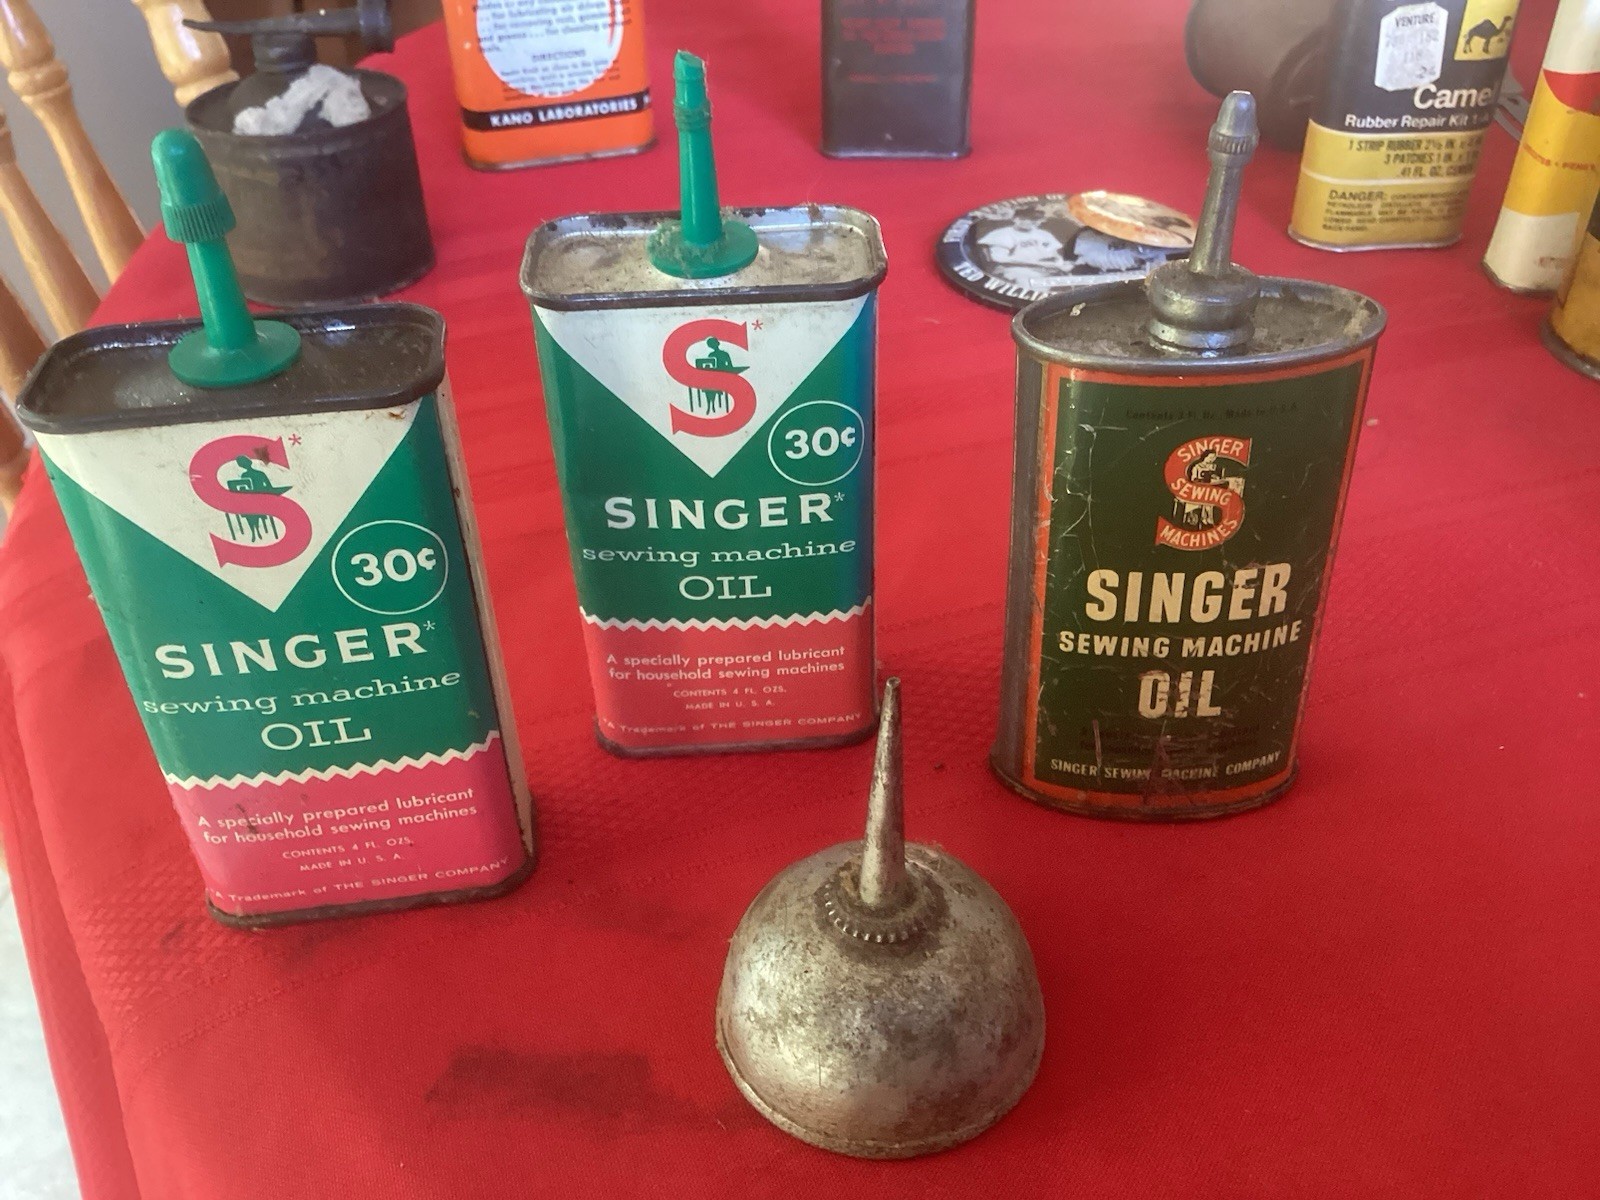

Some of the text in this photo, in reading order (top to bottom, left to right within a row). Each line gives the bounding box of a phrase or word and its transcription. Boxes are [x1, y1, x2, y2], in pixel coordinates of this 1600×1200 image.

[1395, 12, 1435, 27] VENTURE
[490, 112, 534, 127] KANO
[538, 97, 638, 122] LABORATORIES
[1344, 113, 1399, 129] Rubber
[1400, 114, 1447, 129] Repair
[1448, 113, 1469, 127] Kit
[1356, 139, 1385, 151] STRIP
[1386, 138, 1423, 150] RUBBER
[1384, 153, 1391, 164] 3
[1392, 152, 1434, 164] PATCHES
[1329, 189, 1387, 201] DANGER:
[953, 261, 985, 282] TED
[784, 425, 856, 460] 30¢
[1177, 438, 1244, 463] SINGER
[1171, 477, 1232, 506] SEWING
[1160, 518, 1238, 547] MACHINES
[350, 546, 437, 587] 30¢
[583, 539, 857, 568] sewing machine
[679, 575, 772, 600] OIL
[1085, 562, 1292, 624] SINGER
[1059, 619, 1302, 659] SEWING MACHINE
[606, 646, 845, 668] A specially prepared lubricant
[609, 662, 845, 680] for household sewing machines
[143, 671, 461, 715] sewing machine
[673, 689, 727, 698] CONTENTS
[762, 685, 787, 694] OZS.
[1138, 669, 1222, 719] OIL
[685, 702, 714, 710] MADE
[261, 717, 372, 751] OIL
[692, 723, 705, 731] of
[710, 721, 736, 730] THE
[742, 718, 792, 728] SINGER
[797, 711, 861, 725] COMPANY
[1051, 758, 1098, 776] SINGER
[1104, 767, 1152, 780] SEWIN
[1225, 751, 1281, 776] COMPANY
[198, 788, 474, 830] A specially prepared lubricant
[203, 806, 477, 844] for household sewing machines
[282, 845, 346, 859] CONTENTS
[352, 843, 359, 851] 4
[386, 836, 414, 847] OZS.
[300, 861, 332, 872] MADE
[339, 858, 352, 867] IN
[228, 889, 306, 902] Trademark
[312, 885, 328, 894] of
[334, 881, 364, 891] THE
[371, 873, 429, 887] SINGER
[435, 856, 508, 879] COMPANY
